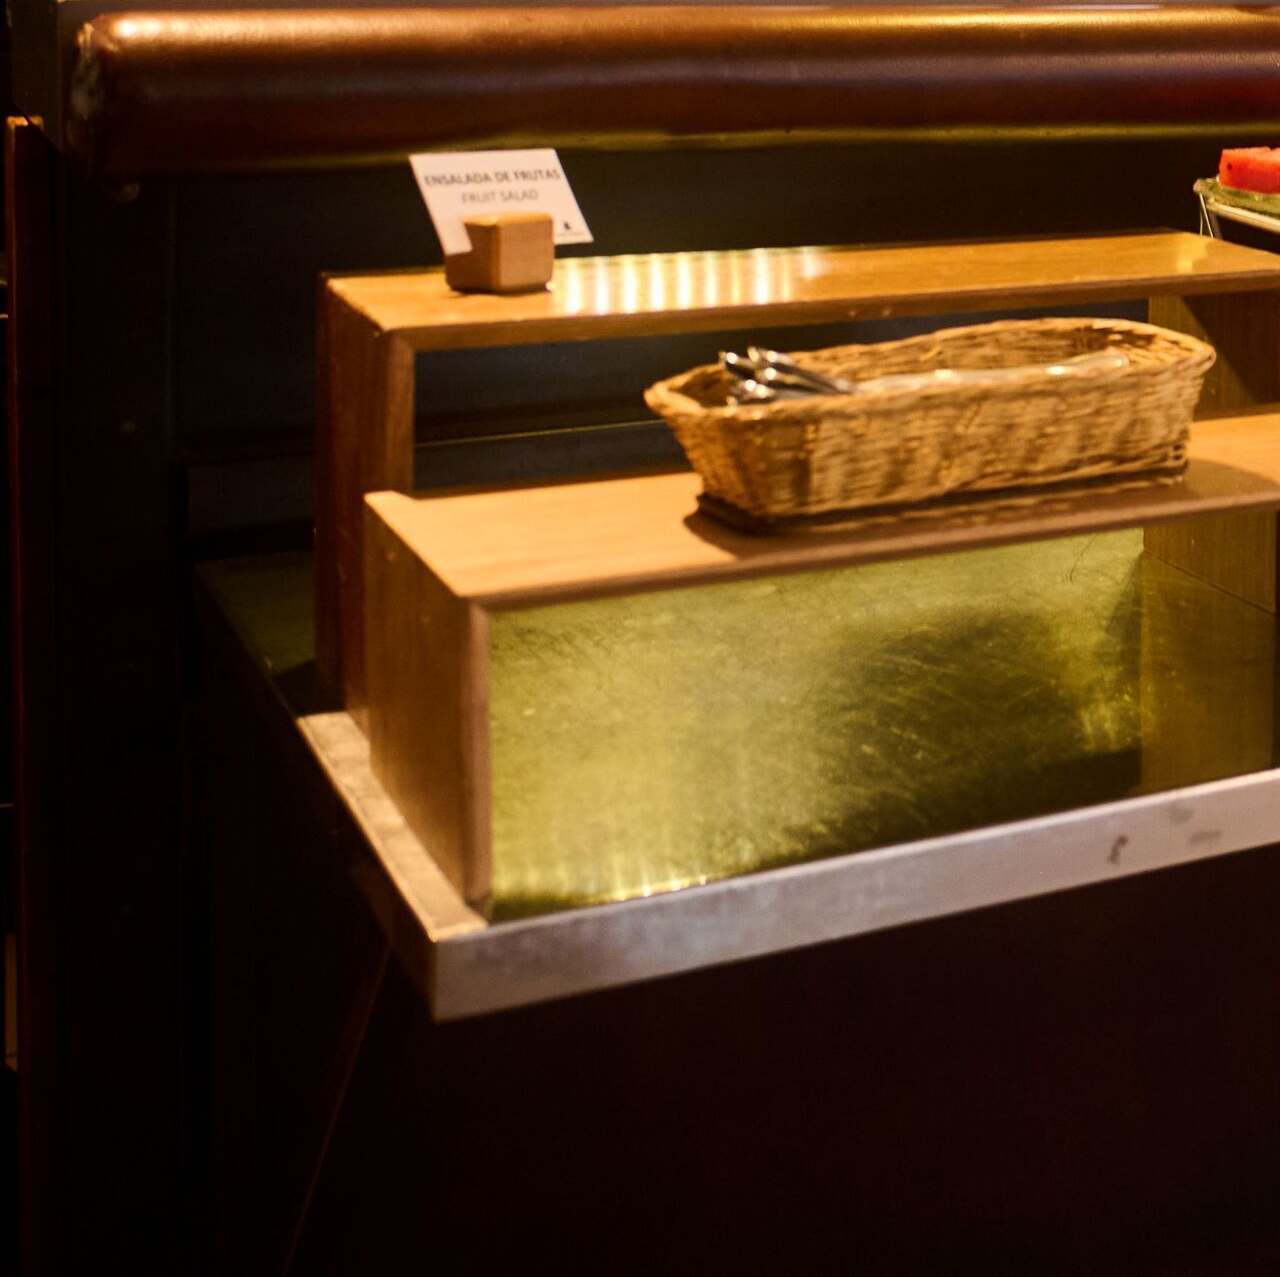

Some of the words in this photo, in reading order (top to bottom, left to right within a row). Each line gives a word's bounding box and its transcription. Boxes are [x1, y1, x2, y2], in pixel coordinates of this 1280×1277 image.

[425, 172, 491, 186] ENSALADA
[496, 171, 509, 182] DE
[514, 169, 561, 181] FRUTAS
[462, 190, 497, 203] FRUIT
[500, 189, 538, 201] SALAD
